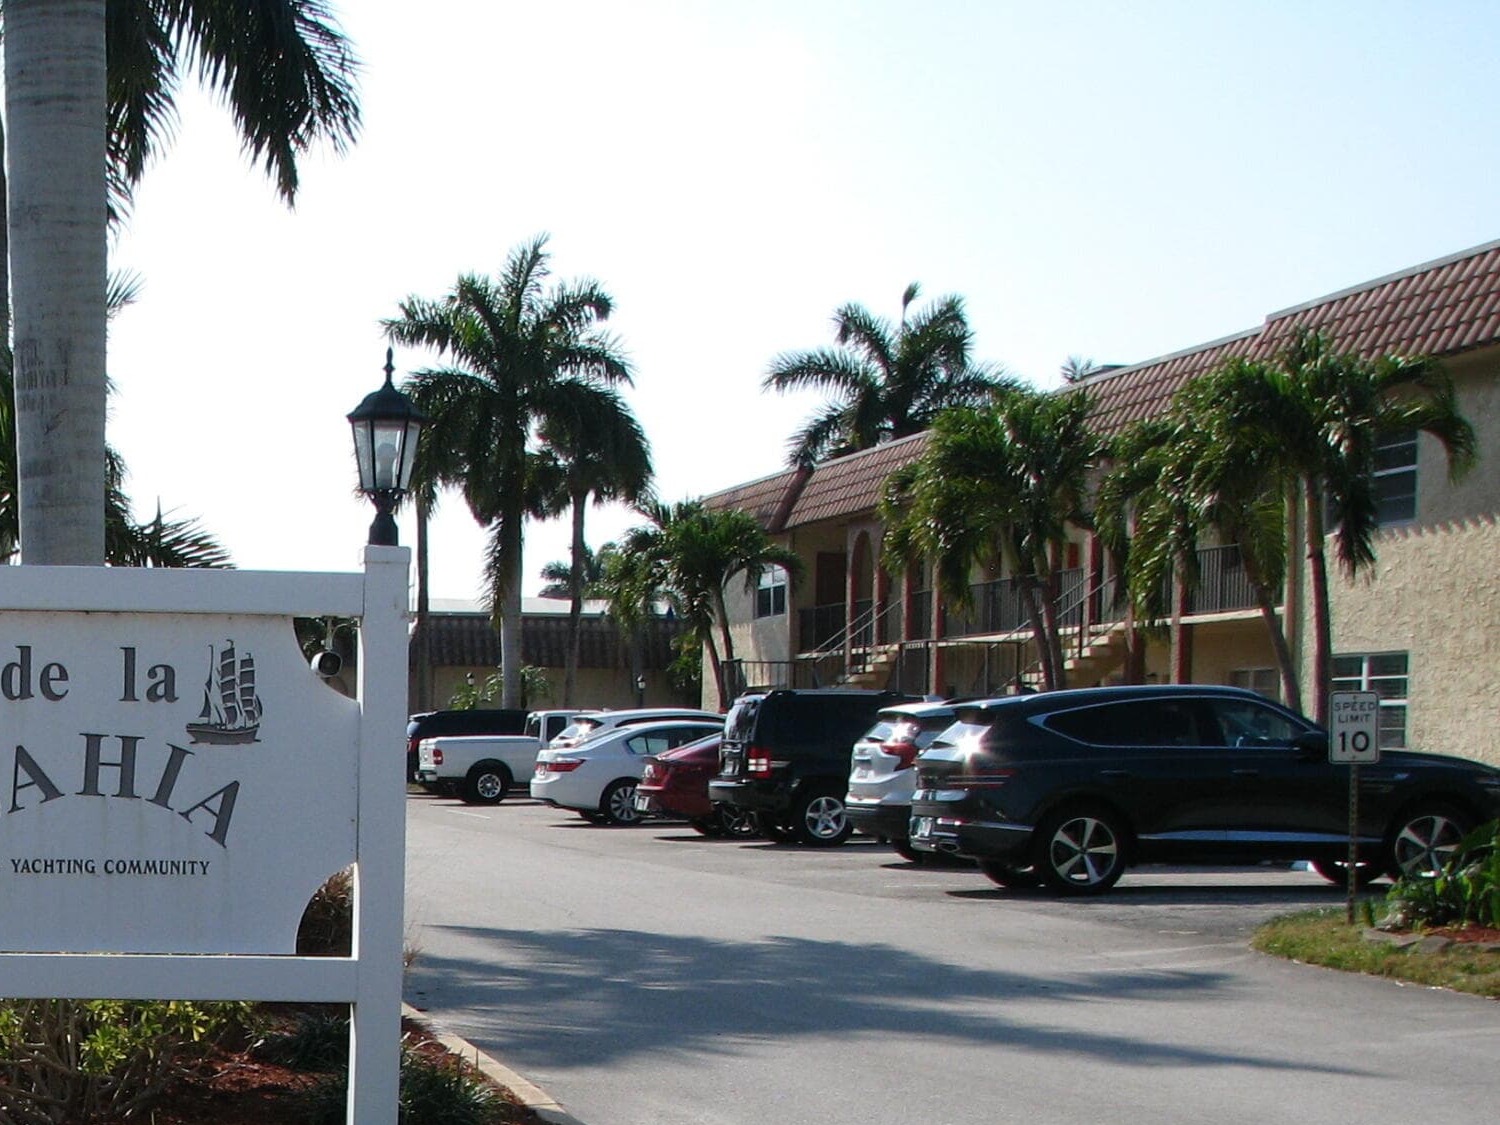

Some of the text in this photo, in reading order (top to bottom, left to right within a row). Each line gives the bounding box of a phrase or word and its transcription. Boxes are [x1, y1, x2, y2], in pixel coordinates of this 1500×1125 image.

[0, 645, 180, 703] de la
[1333, 701, 1376, 712] SPEED
[1338, 713, 1371, 723] LIMIT
[1338, 730, 1370, 752] 10
[11, 858, 96, 874] YACHTING
[104, 859, 210, 875] COMMUNITY
